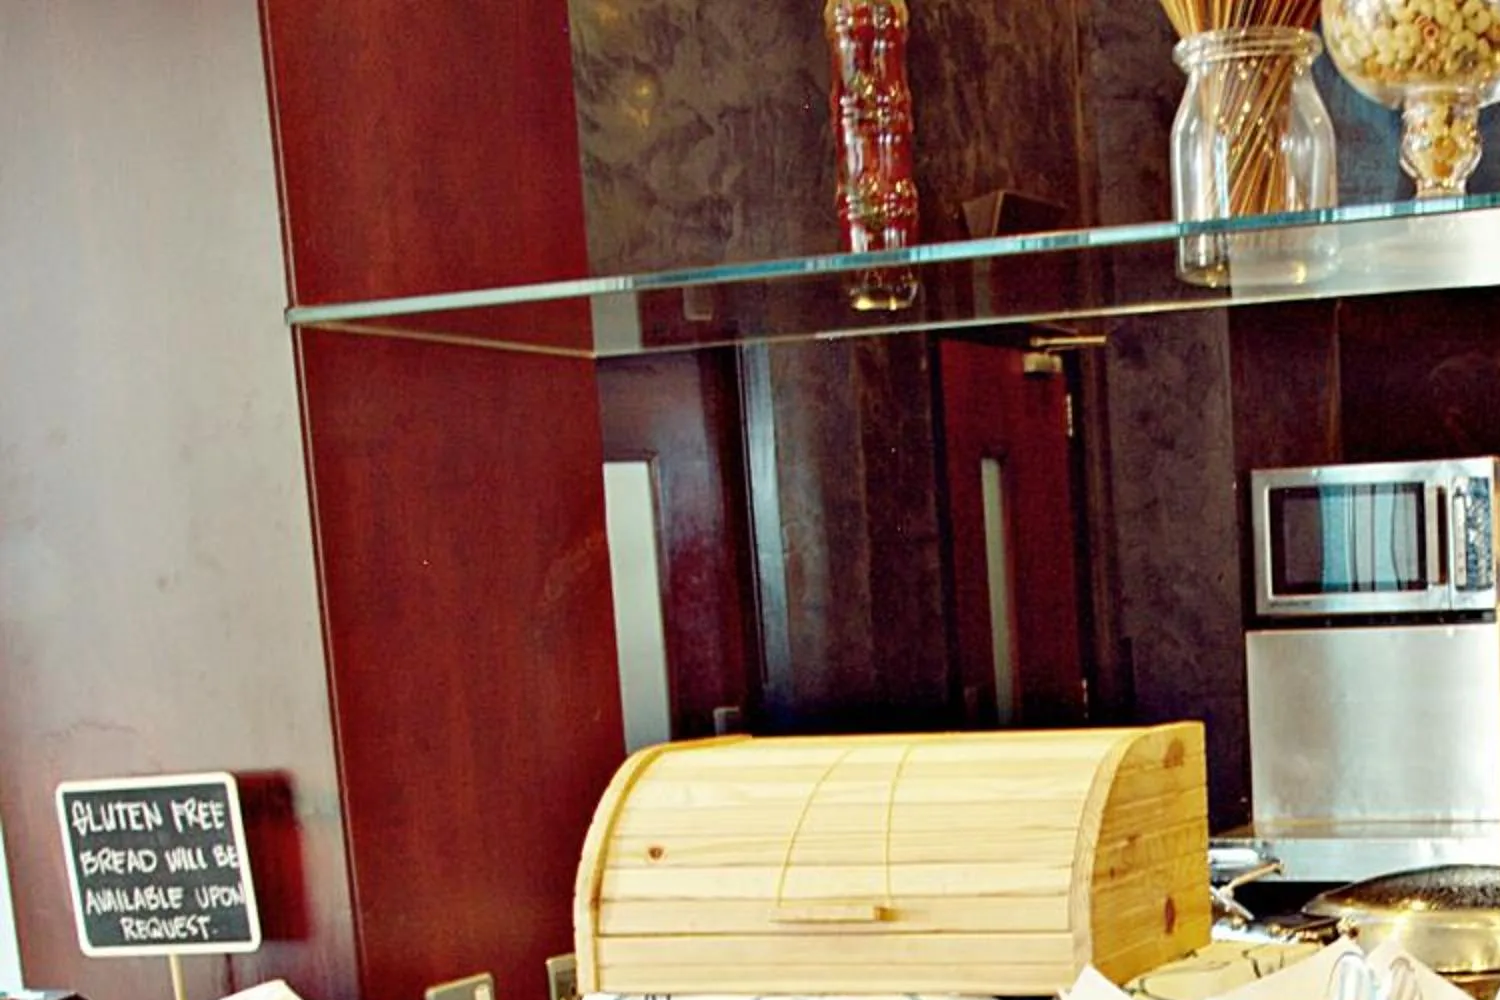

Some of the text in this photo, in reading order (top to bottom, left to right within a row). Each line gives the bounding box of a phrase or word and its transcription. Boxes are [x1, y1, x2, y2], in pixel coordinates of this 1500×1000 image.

[71, 797, 225, 836] GLUTEN FREE
[79, 844, 240, 877] BREAD WILL BE
[85, 881, 247, 916] AVAILABLE UPON
